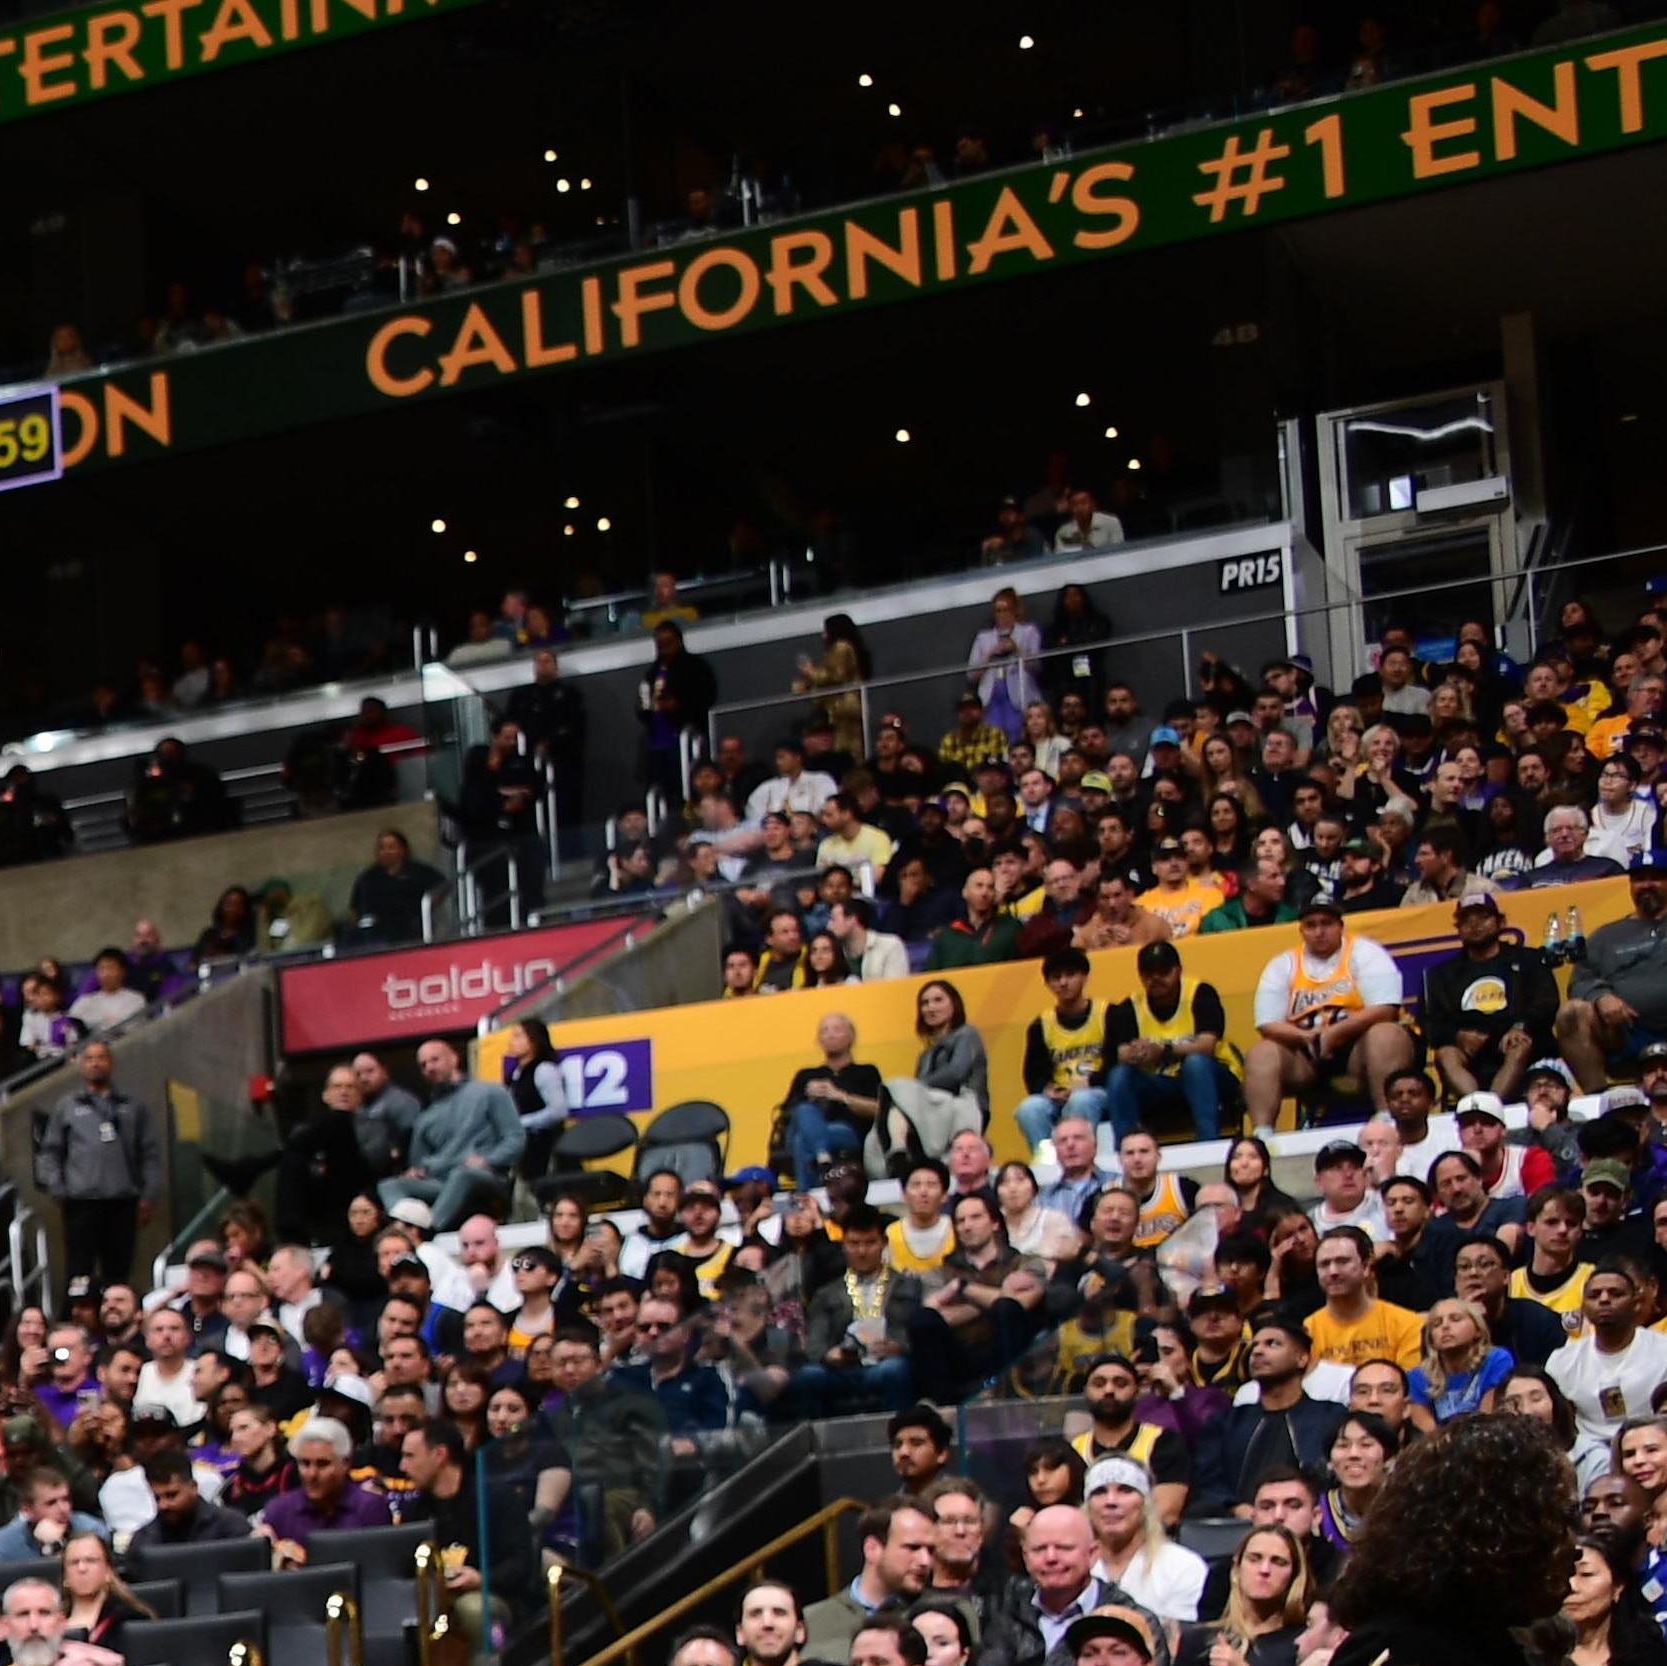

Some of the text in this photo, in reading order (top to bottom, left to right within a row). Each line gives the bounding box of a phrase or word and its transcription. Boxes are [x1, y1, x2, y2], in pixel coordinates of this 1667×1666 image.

[366, 39, 1667, 397] CALIFORNIA'S #1 ENT
[1221, 556, 1281, 591] PR15
